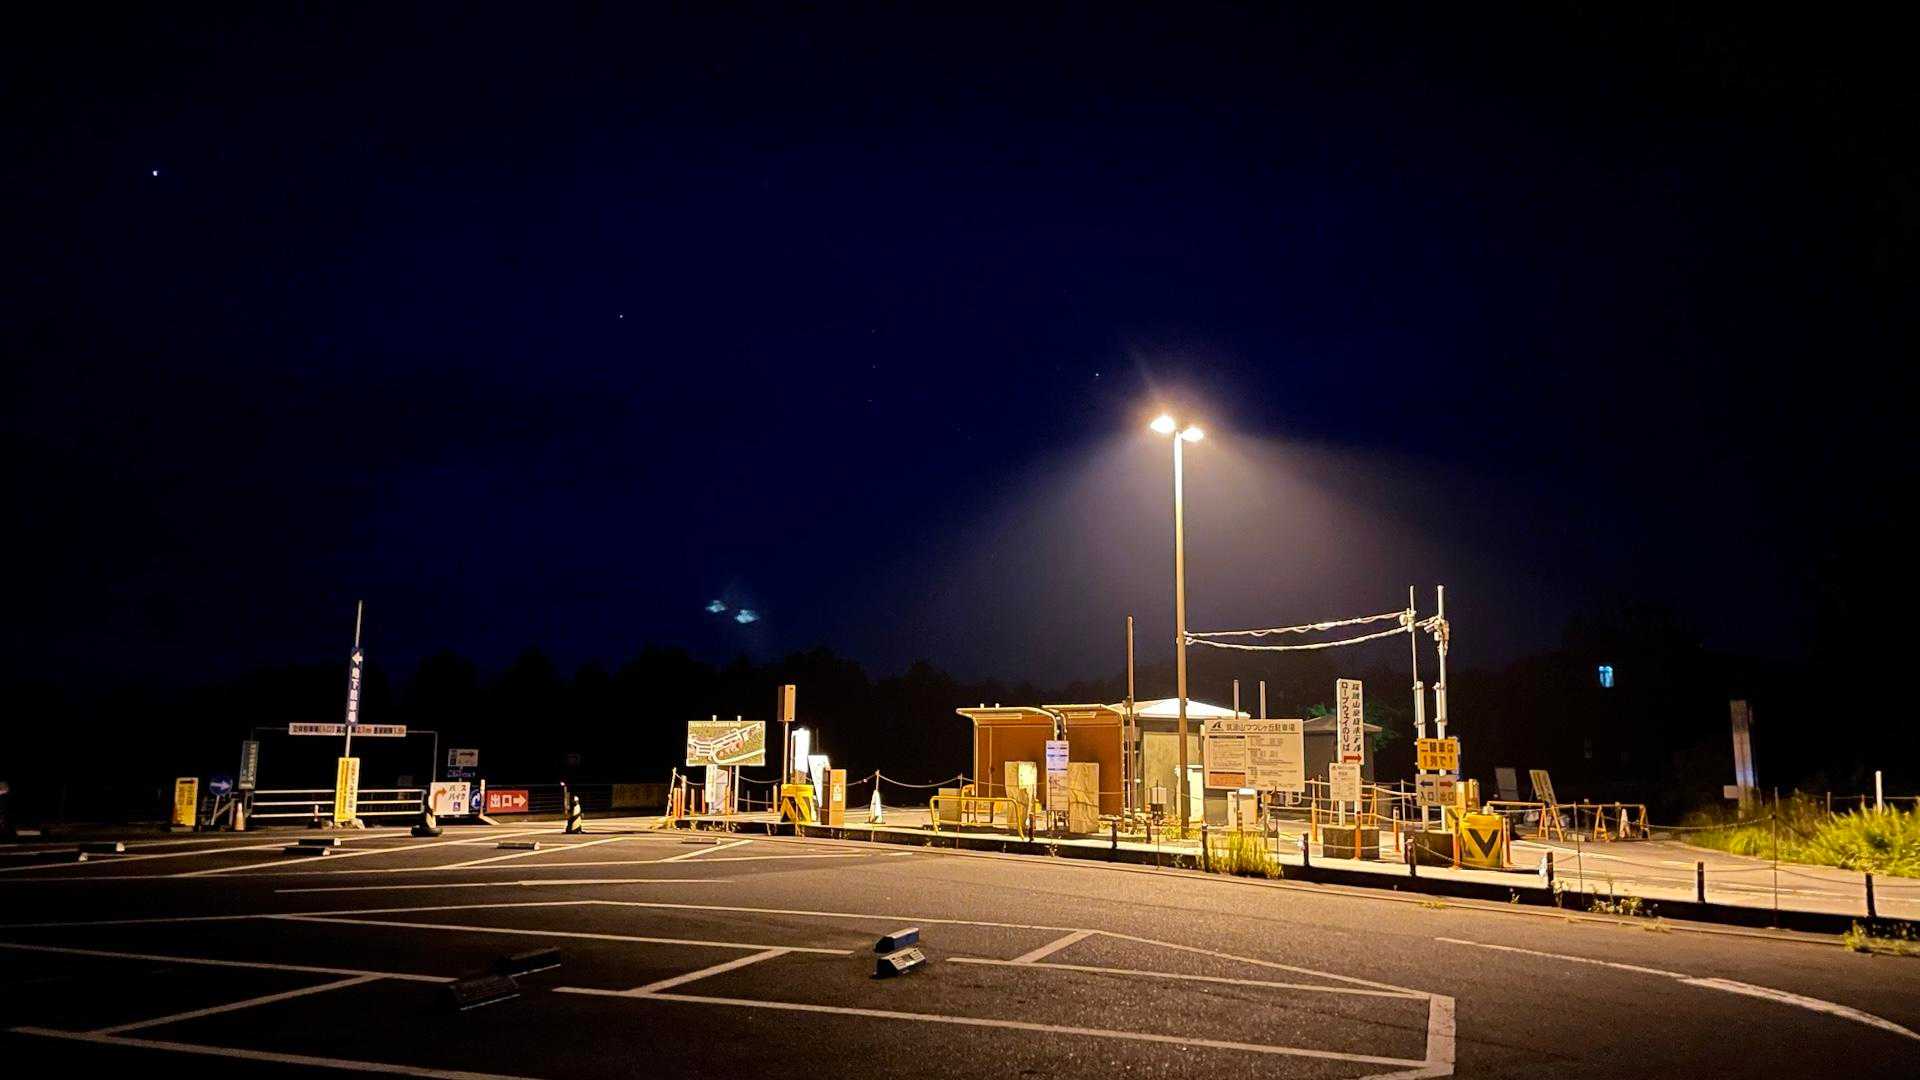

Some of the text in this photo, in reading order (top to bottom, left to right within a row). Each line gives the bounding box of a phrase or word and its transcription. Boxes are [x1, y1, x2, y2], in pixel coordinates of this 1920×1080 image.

[1341, 681, 1350, 752] ロープウェイのりば
[490, 794, 512, 808] 出口
